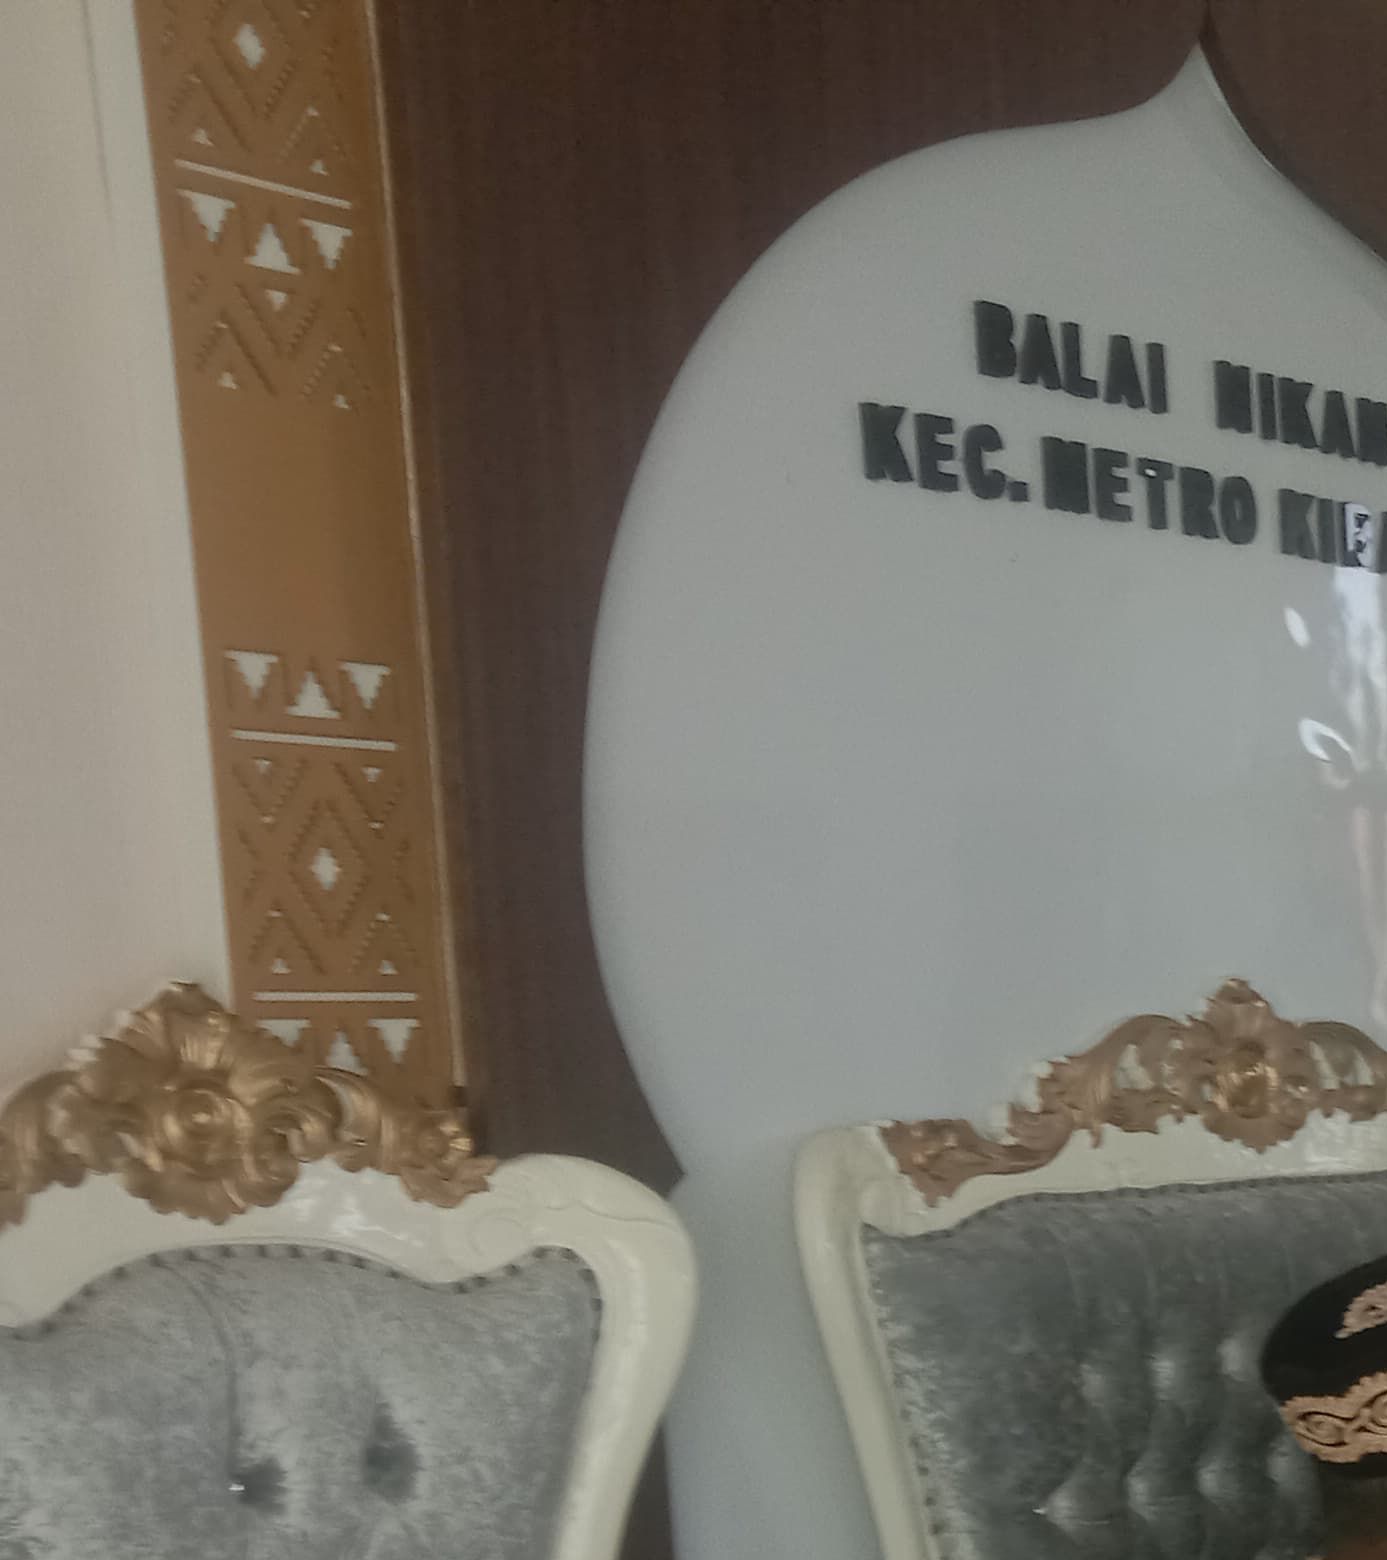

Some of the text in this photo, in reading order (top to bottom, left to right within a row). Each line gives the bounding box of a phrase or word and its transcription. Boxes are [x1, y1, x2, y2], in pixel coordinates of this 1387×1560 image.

[974, 300, 1168, 414] BALAI
[858, 402, 1030, 502] KEC.
[1040, 435, 1258, 545] METRO
